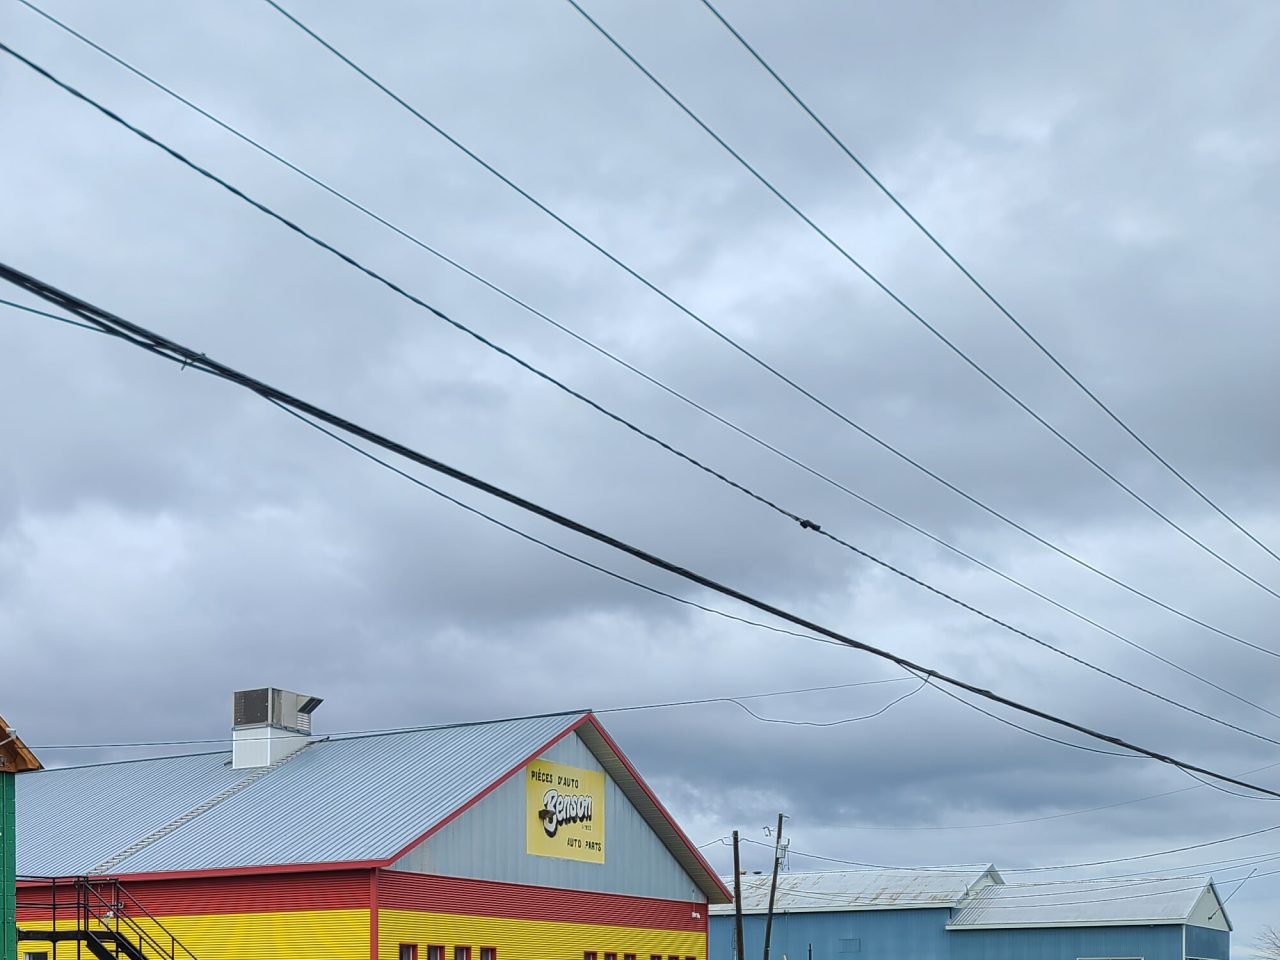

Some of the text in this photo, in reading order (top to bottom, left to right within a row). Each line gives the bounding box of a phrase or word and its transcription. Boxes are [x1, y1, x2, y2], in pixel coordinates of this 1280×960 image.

[542, 788, 593, 836] Benson
[566, 837, 602, 852] AUTO PARTS
